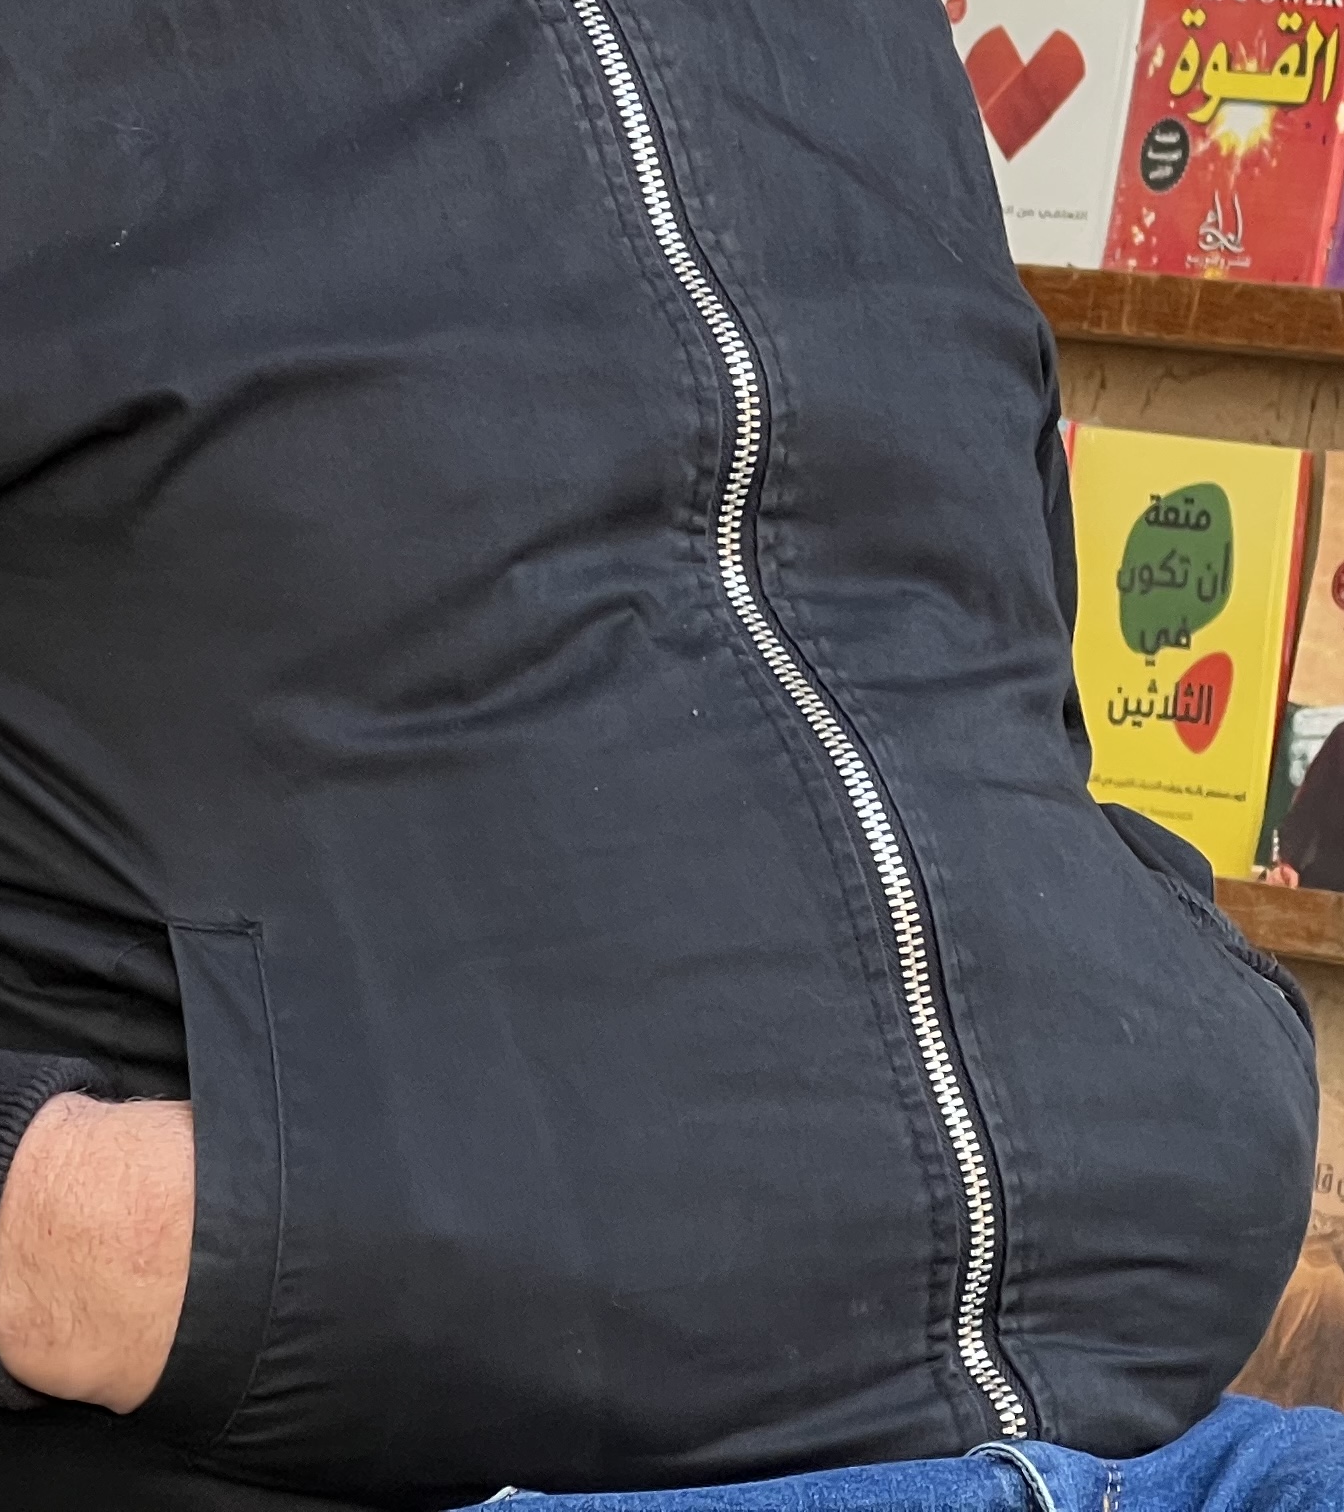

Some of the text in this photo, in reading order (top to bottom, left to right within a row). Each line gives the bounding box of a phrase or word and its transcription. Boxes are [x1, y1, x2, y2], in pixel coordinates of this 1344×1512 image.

[1169, 7, 1341, 124] القوة
[1144, 493, 1212, 532] متعة
[1138, 615, 1194, 667] في
[1107, 677, 1215, 728] الثلاثين
